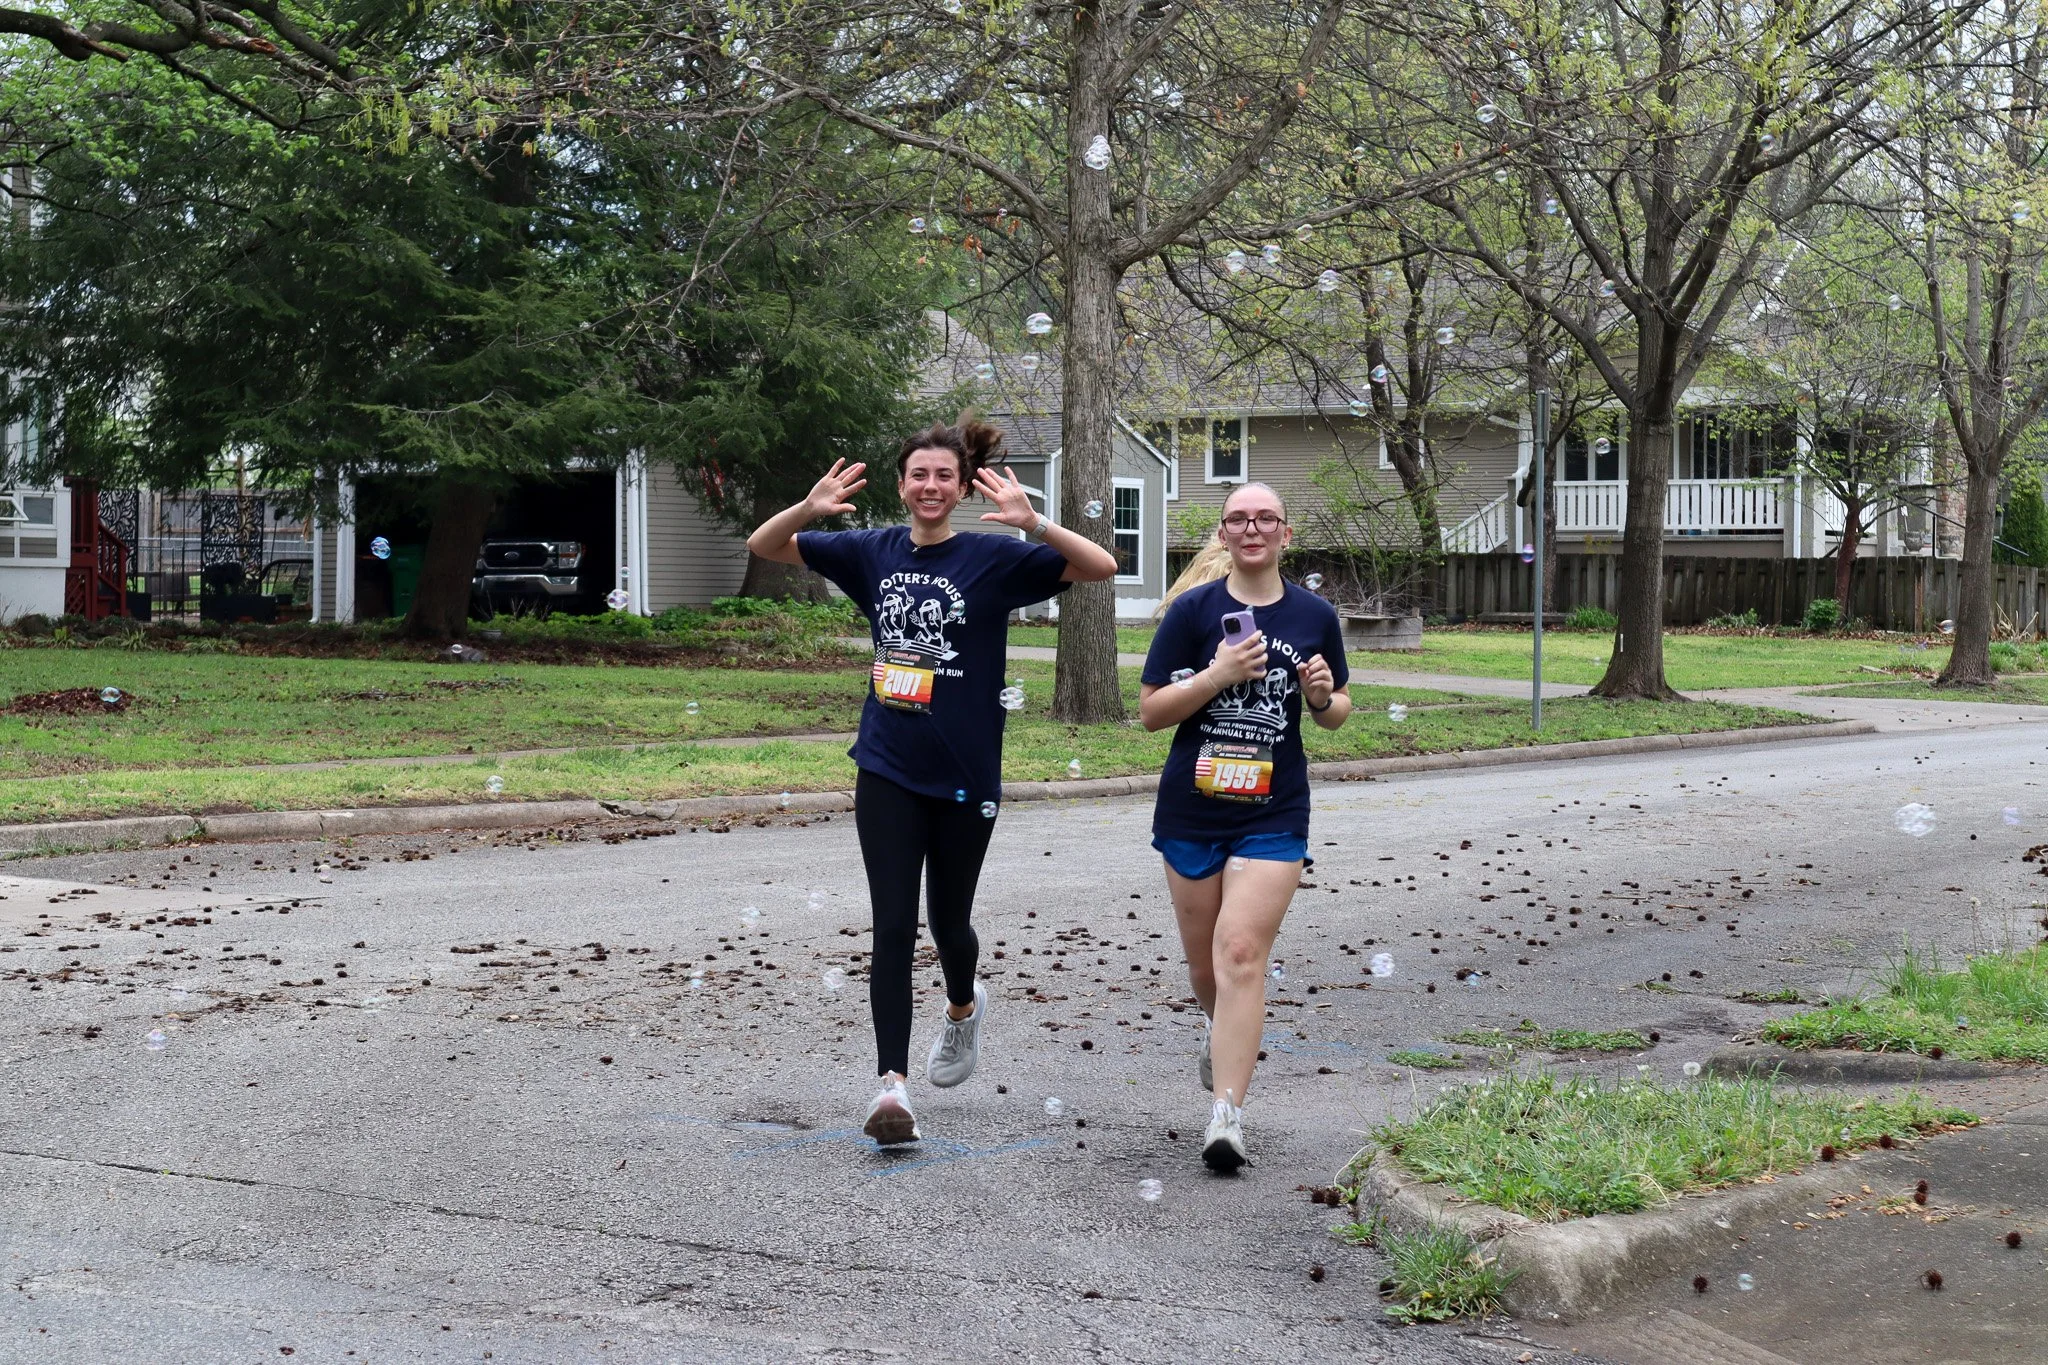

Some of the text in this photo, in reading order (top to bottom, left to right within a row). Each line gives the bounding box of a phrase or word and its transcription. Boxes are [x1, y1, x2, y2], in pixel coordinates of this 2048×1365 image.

[1271, 638, 1302, 664] HOU
[883, 668, 922, 697] 2001
[934, 667, 964, 678] UN RUN
[1211, 727, 1243, 738] ANNUAL
[1212, 763, 1261, 790] 1955
